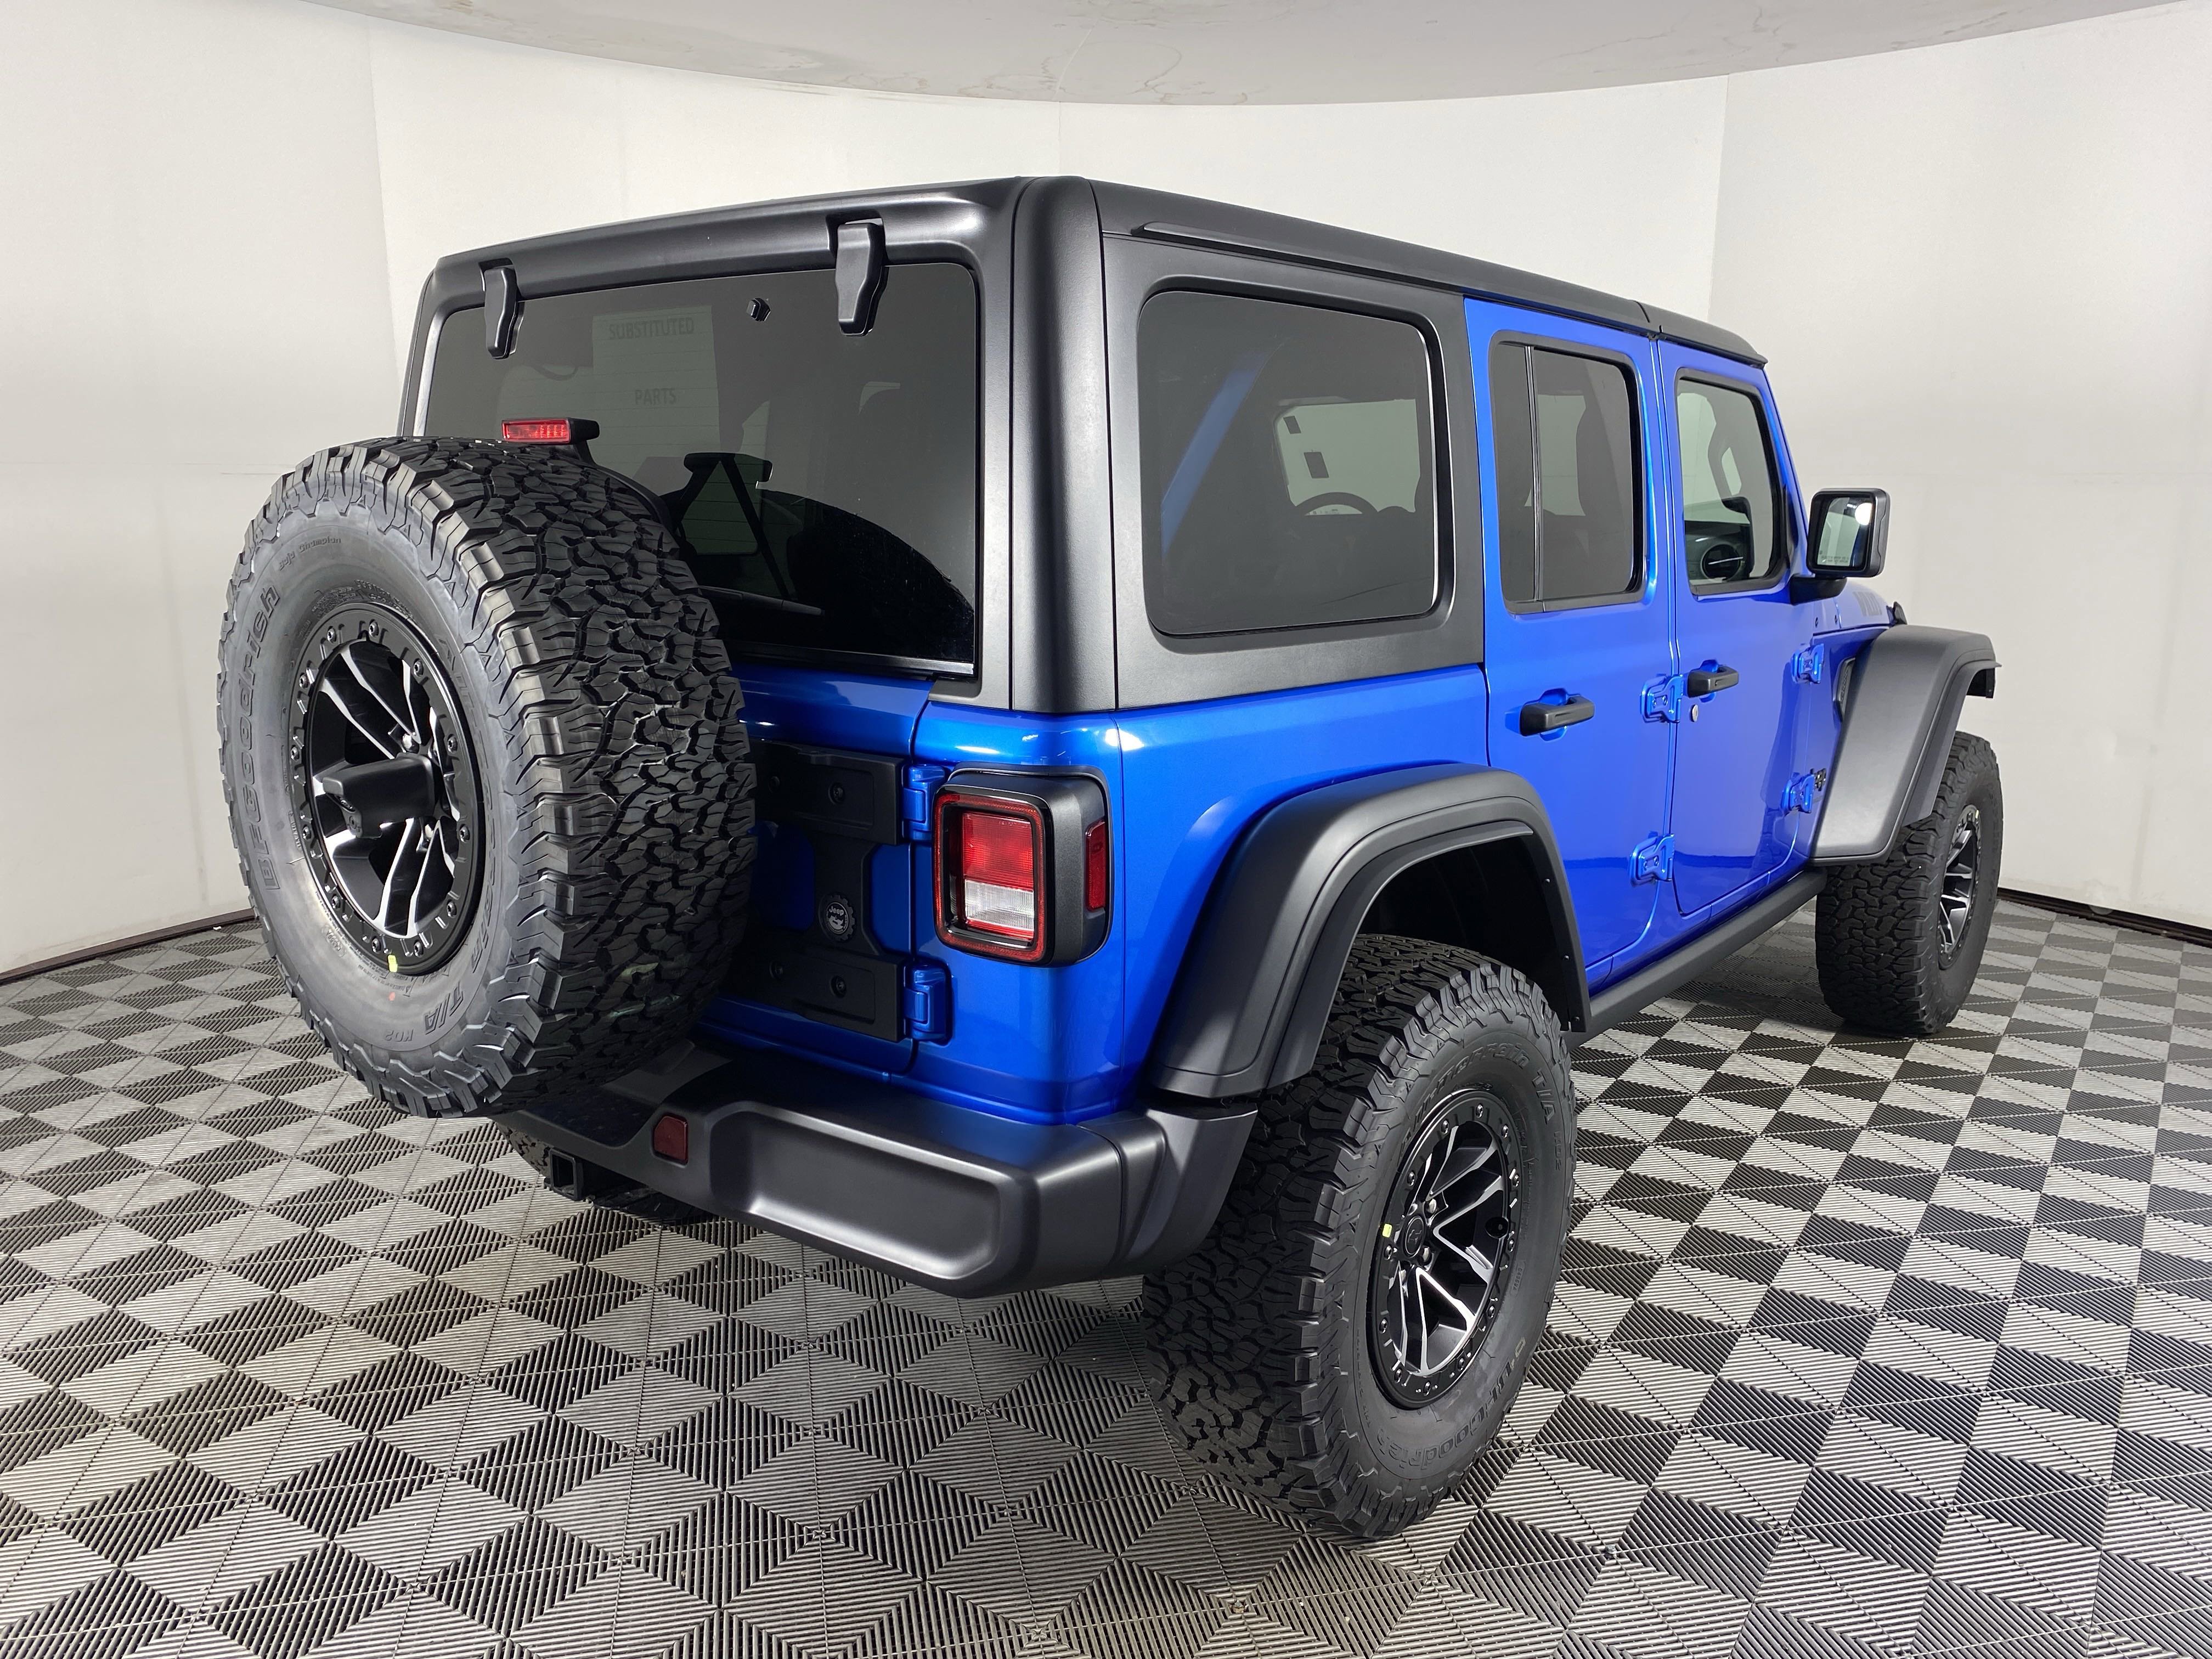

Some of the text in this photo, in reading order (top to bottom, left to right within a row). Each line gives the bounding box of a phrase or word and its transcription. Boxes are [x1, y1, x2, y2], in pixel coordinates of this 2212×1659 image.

[609, 317, 694, 339] SUBSTITUTED
[635, 387, 676, 405] PARTS
[239, 585, 280, 890] BFGoodrich
[829, 906, 844, 916] Jeep
